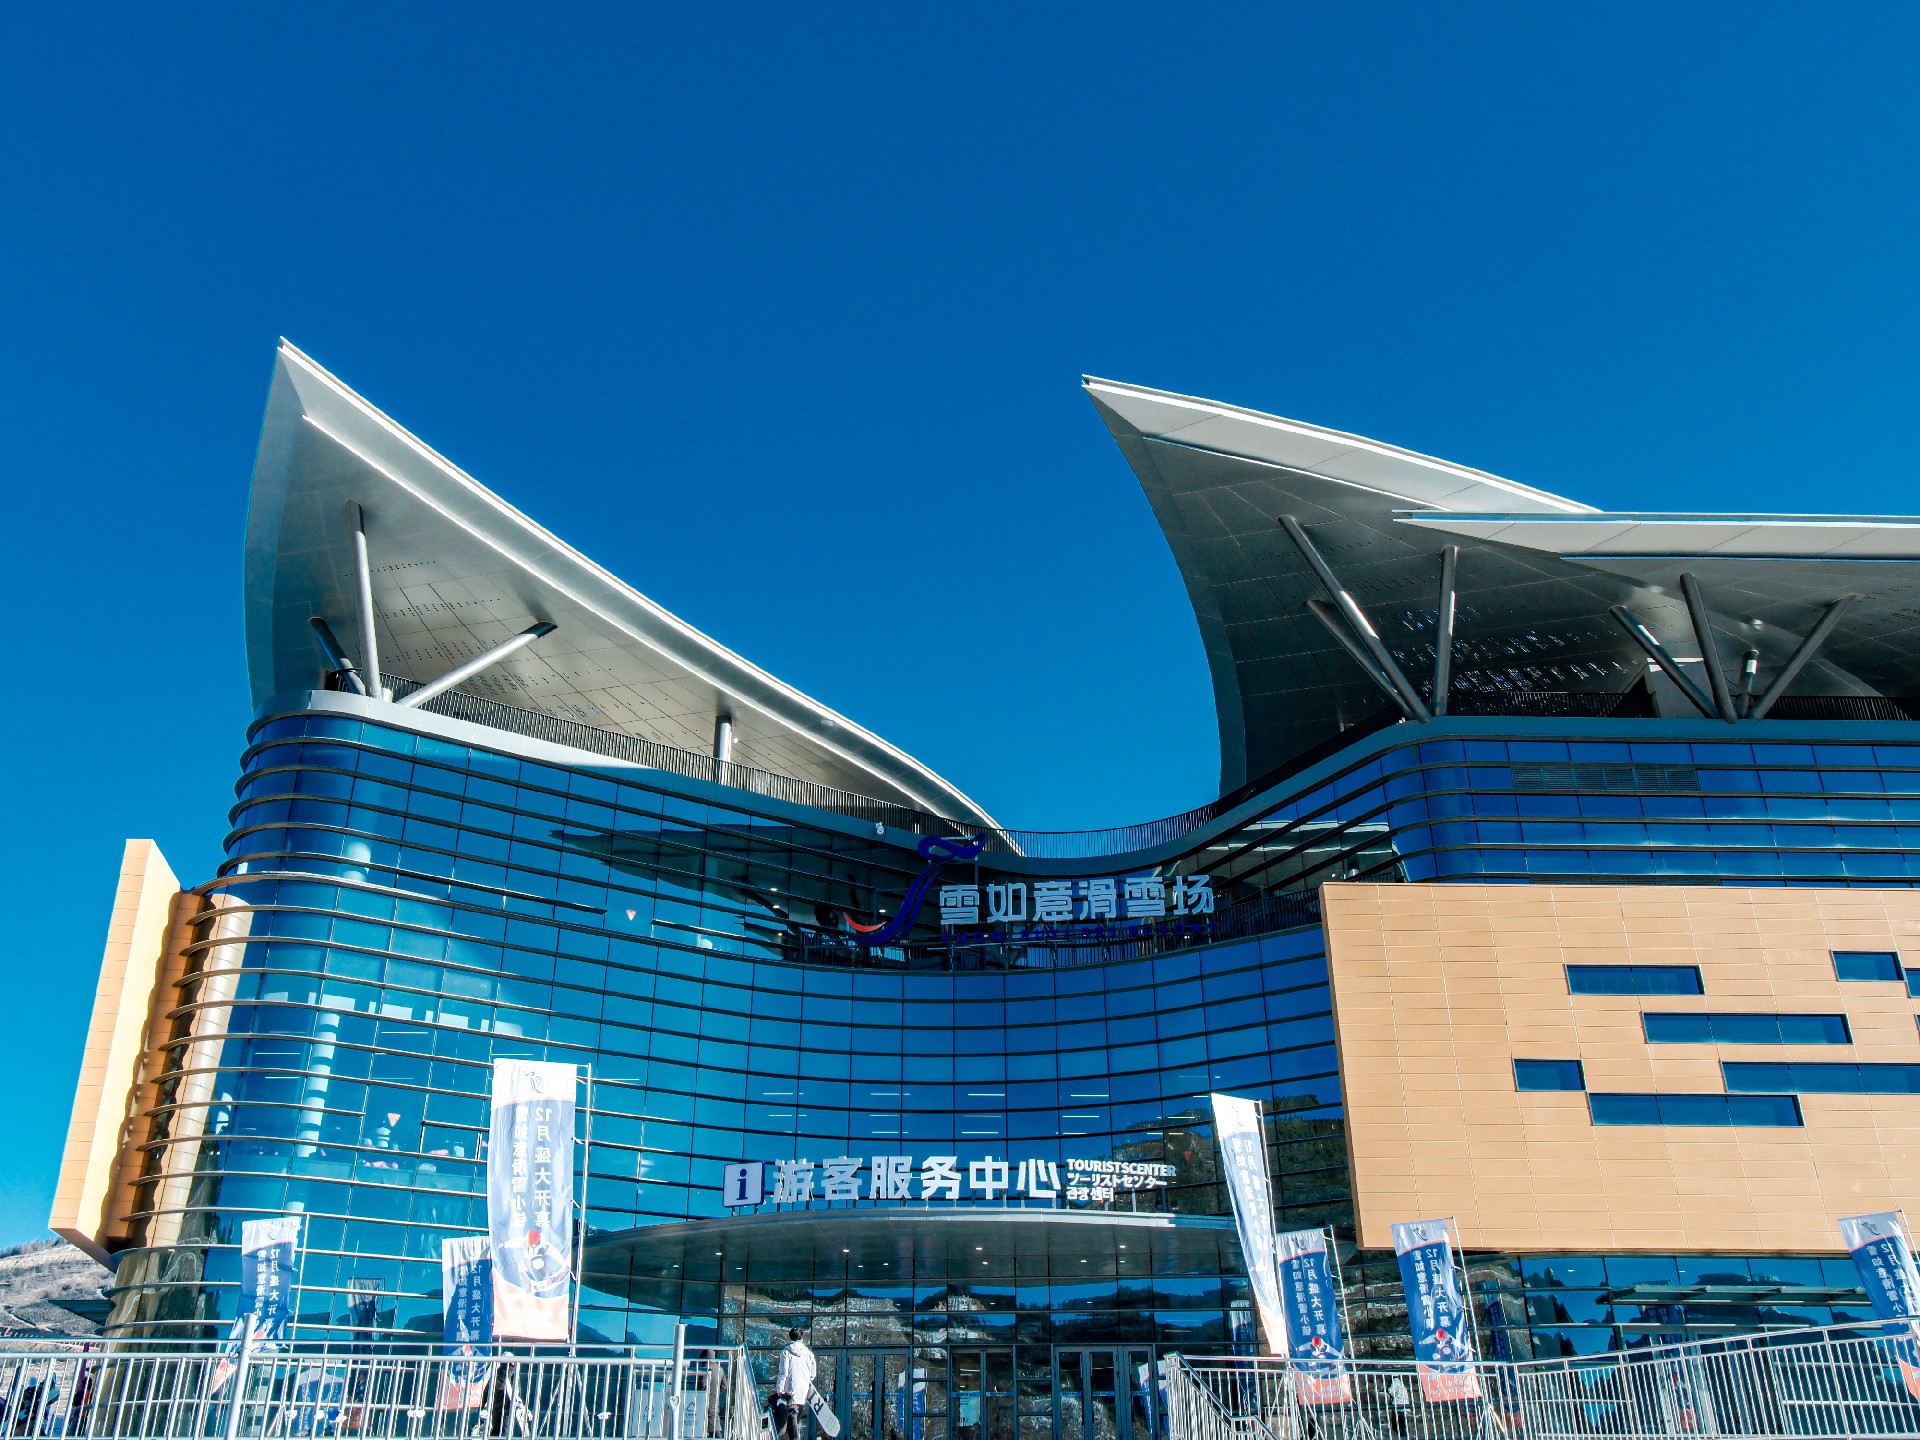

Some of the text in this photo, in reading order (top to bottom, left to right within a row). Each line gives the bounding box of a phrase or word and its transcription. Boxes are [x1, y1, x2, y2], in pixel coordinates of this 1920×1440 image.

[939, 874, 1214, 925] 雪如意滑雪场
[941, 931, 1005, 945] SNOW
[773, 1155, 1061, 1203] 游客服务中心
